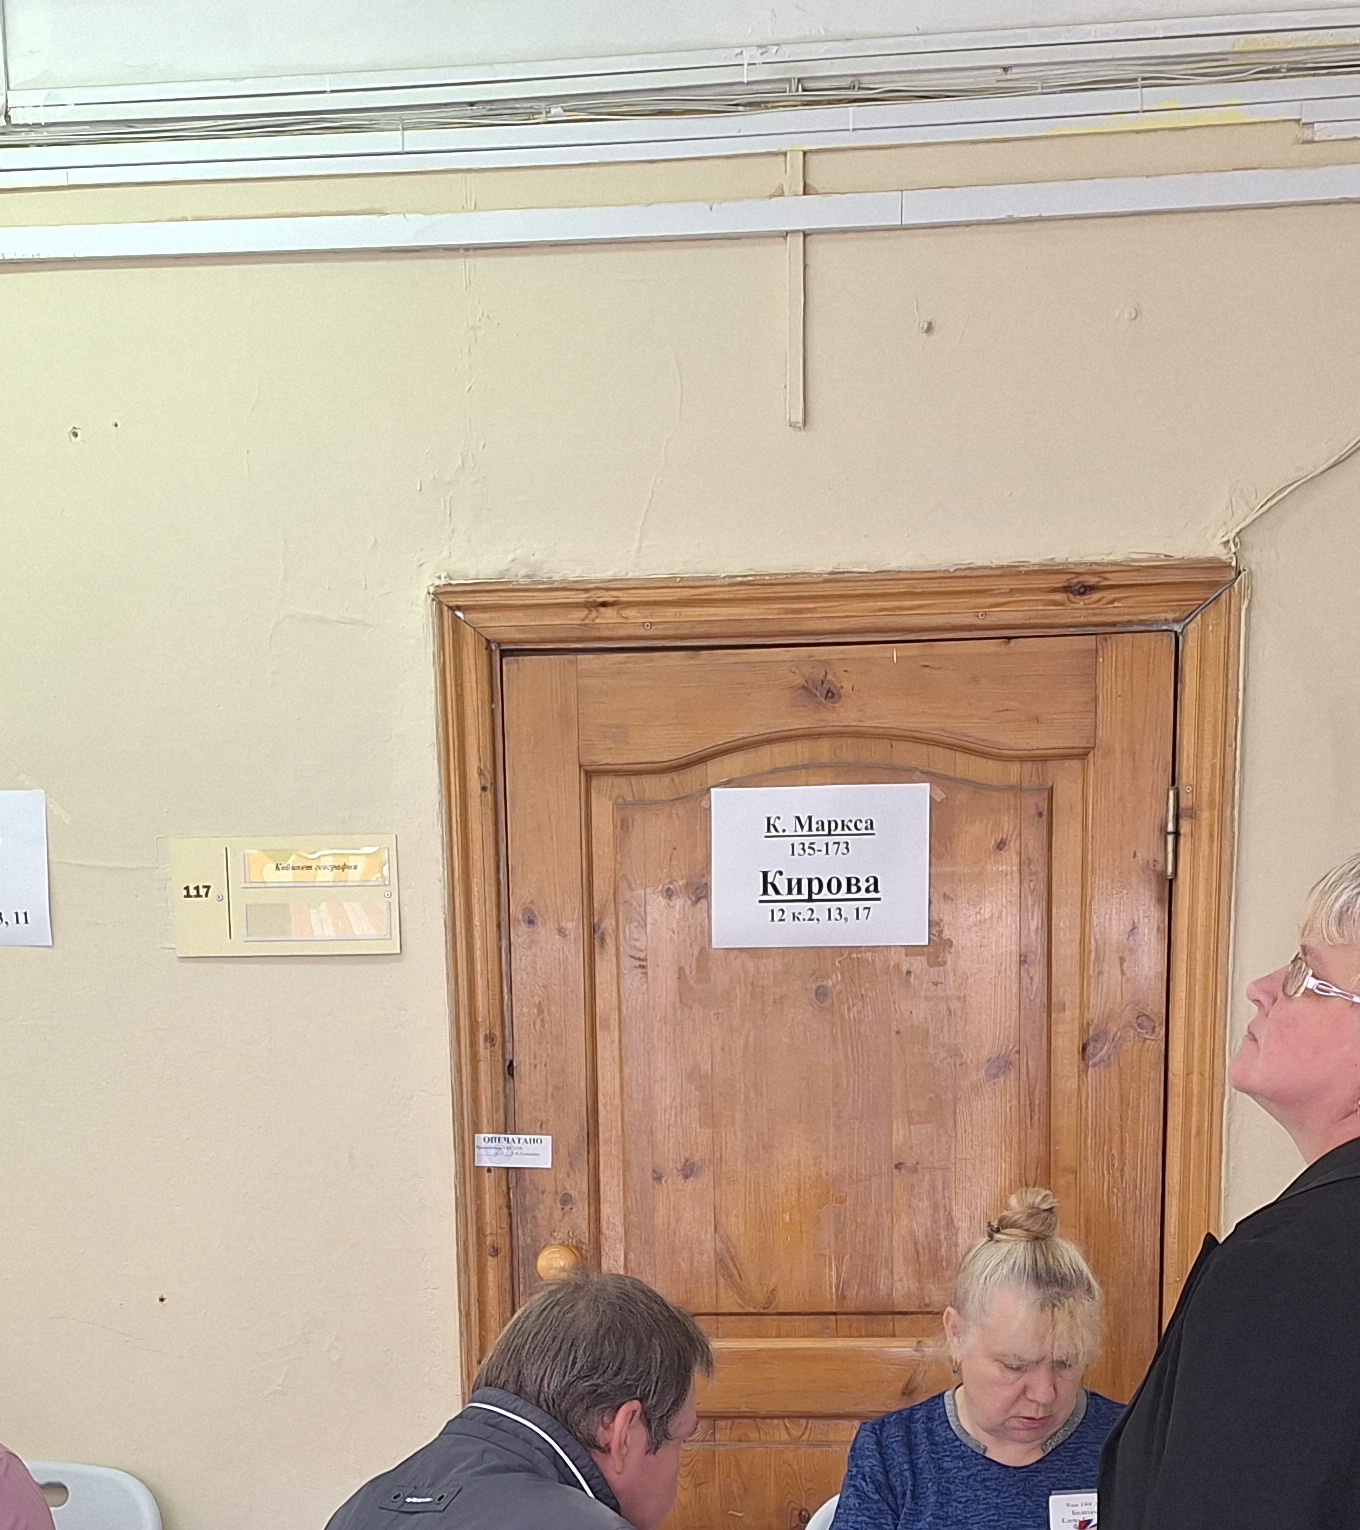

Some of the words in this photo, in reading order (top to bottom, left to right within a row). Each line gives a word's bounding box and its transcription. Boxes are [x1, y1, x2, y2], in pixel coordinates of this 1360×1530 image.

[764, 815, 786, 834] К.
[793, 815, 875, 836] Маркса
[789, 841, 851, 857] 135-173
[182, 885, 212, 899] 117
[759, 870, 881, 900] Кирова
[13, 911, 30, 925] 11
[768, 908, 786, 923] 12
[791, 907, 821, 924] к.2,
[826, 907, 849, 924] 13,
[854, 906, 871, 921] 17
